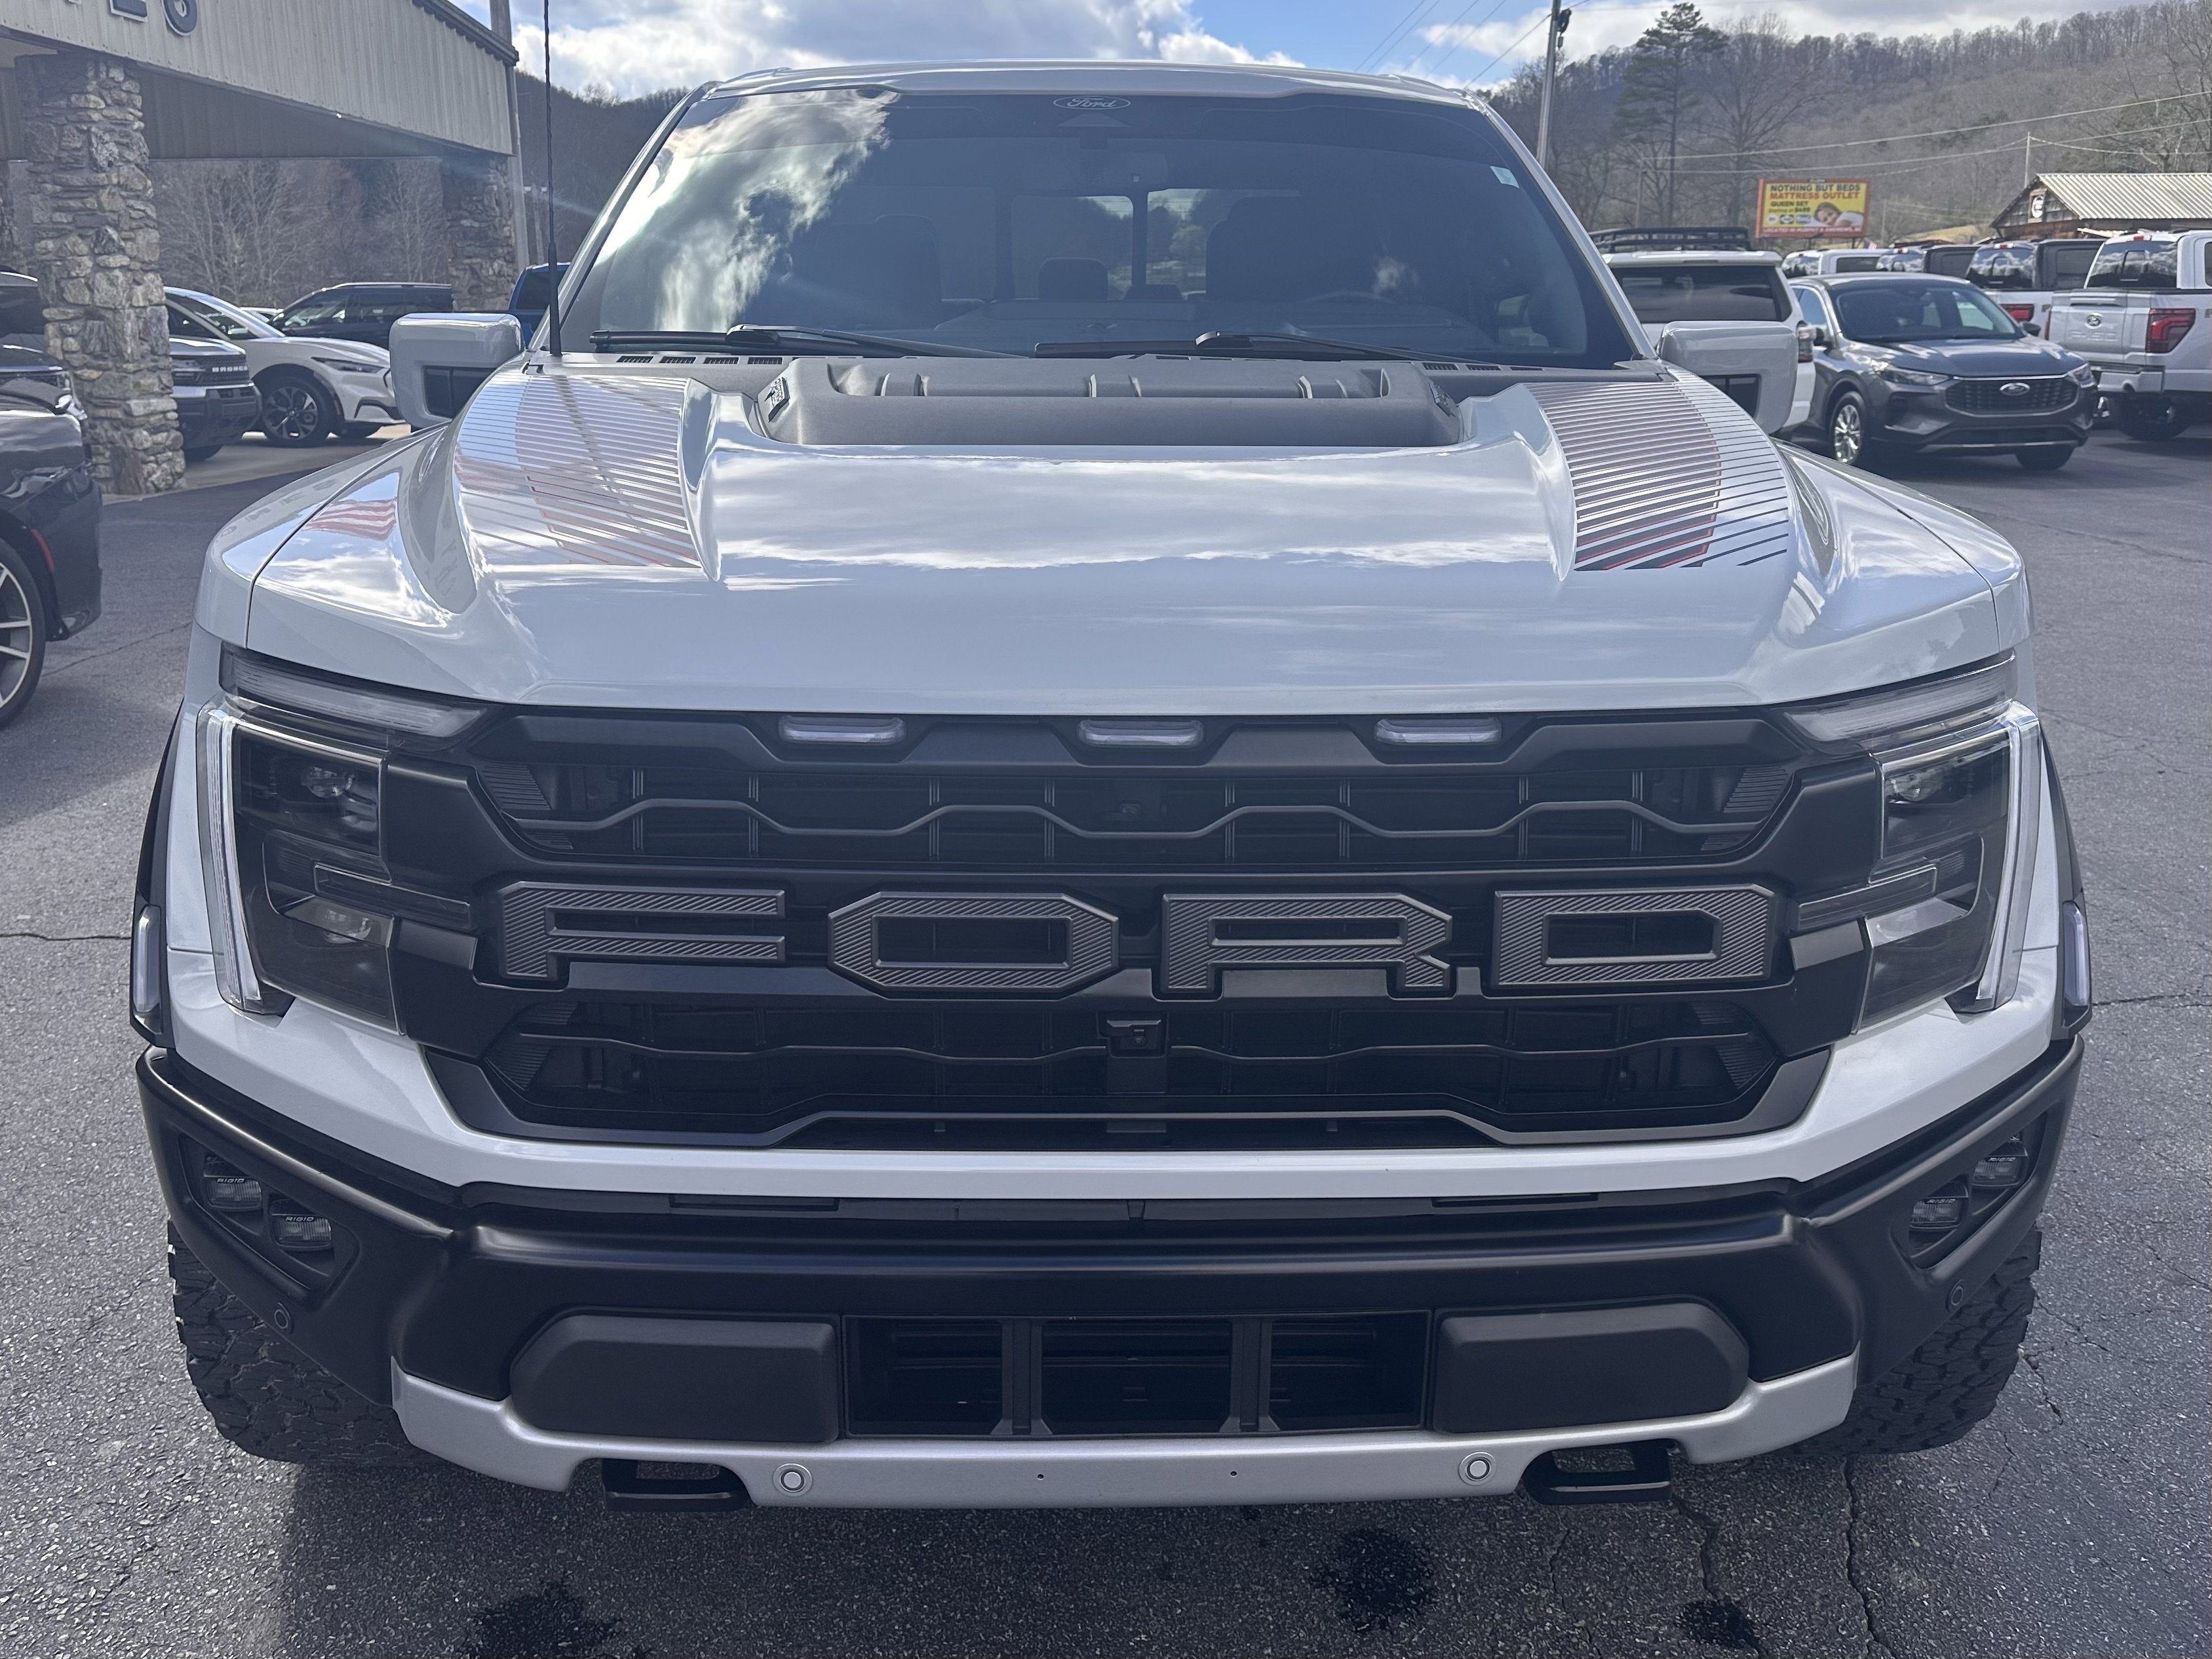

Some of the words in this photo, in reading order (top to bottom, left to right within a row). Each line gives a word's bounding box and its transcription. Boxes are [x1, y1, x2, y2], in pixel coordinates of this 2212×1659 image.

[1066, 98, 1117, 107] Ford
[1836, 183, 1861, 191] BEDS
[499, 880, 1775, 994] FORD
